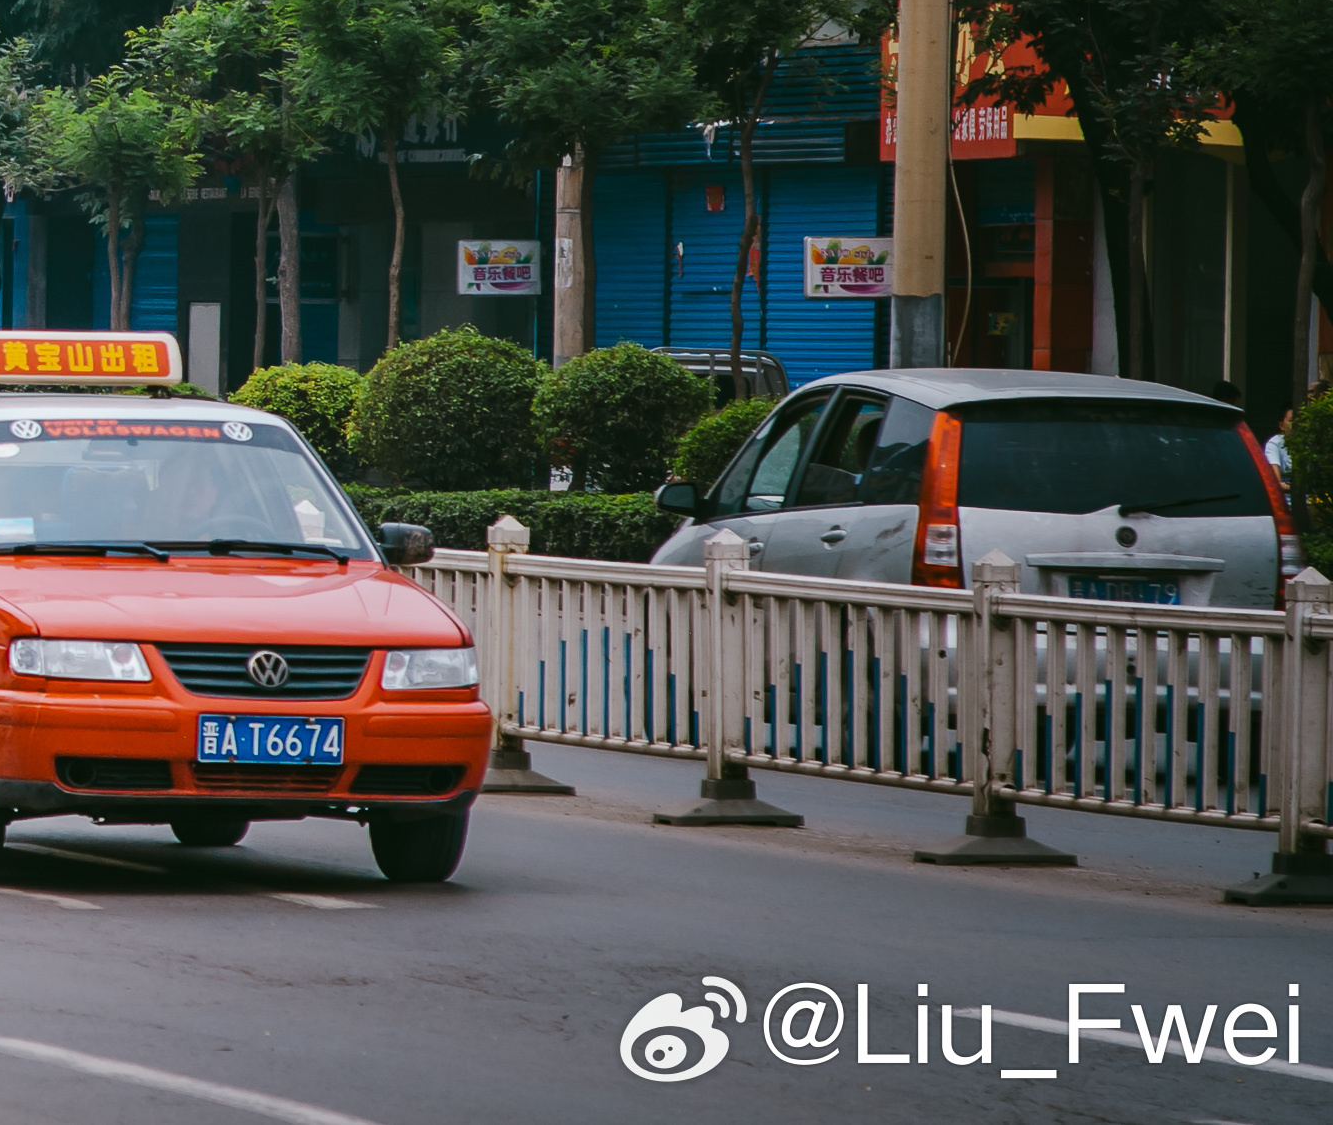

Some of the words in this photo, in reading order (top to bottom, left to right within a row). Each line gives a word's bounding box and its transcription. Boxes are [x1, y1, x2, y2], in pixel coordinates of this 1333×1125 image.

[473, 265, 531, 281] 音乐餐吧
[821, 267, 884, 283] 音乐餐吧
[2, 341, 159, 373] 黄宝山出租
[46, 424, 220, 438] VOLKSWAGEN
